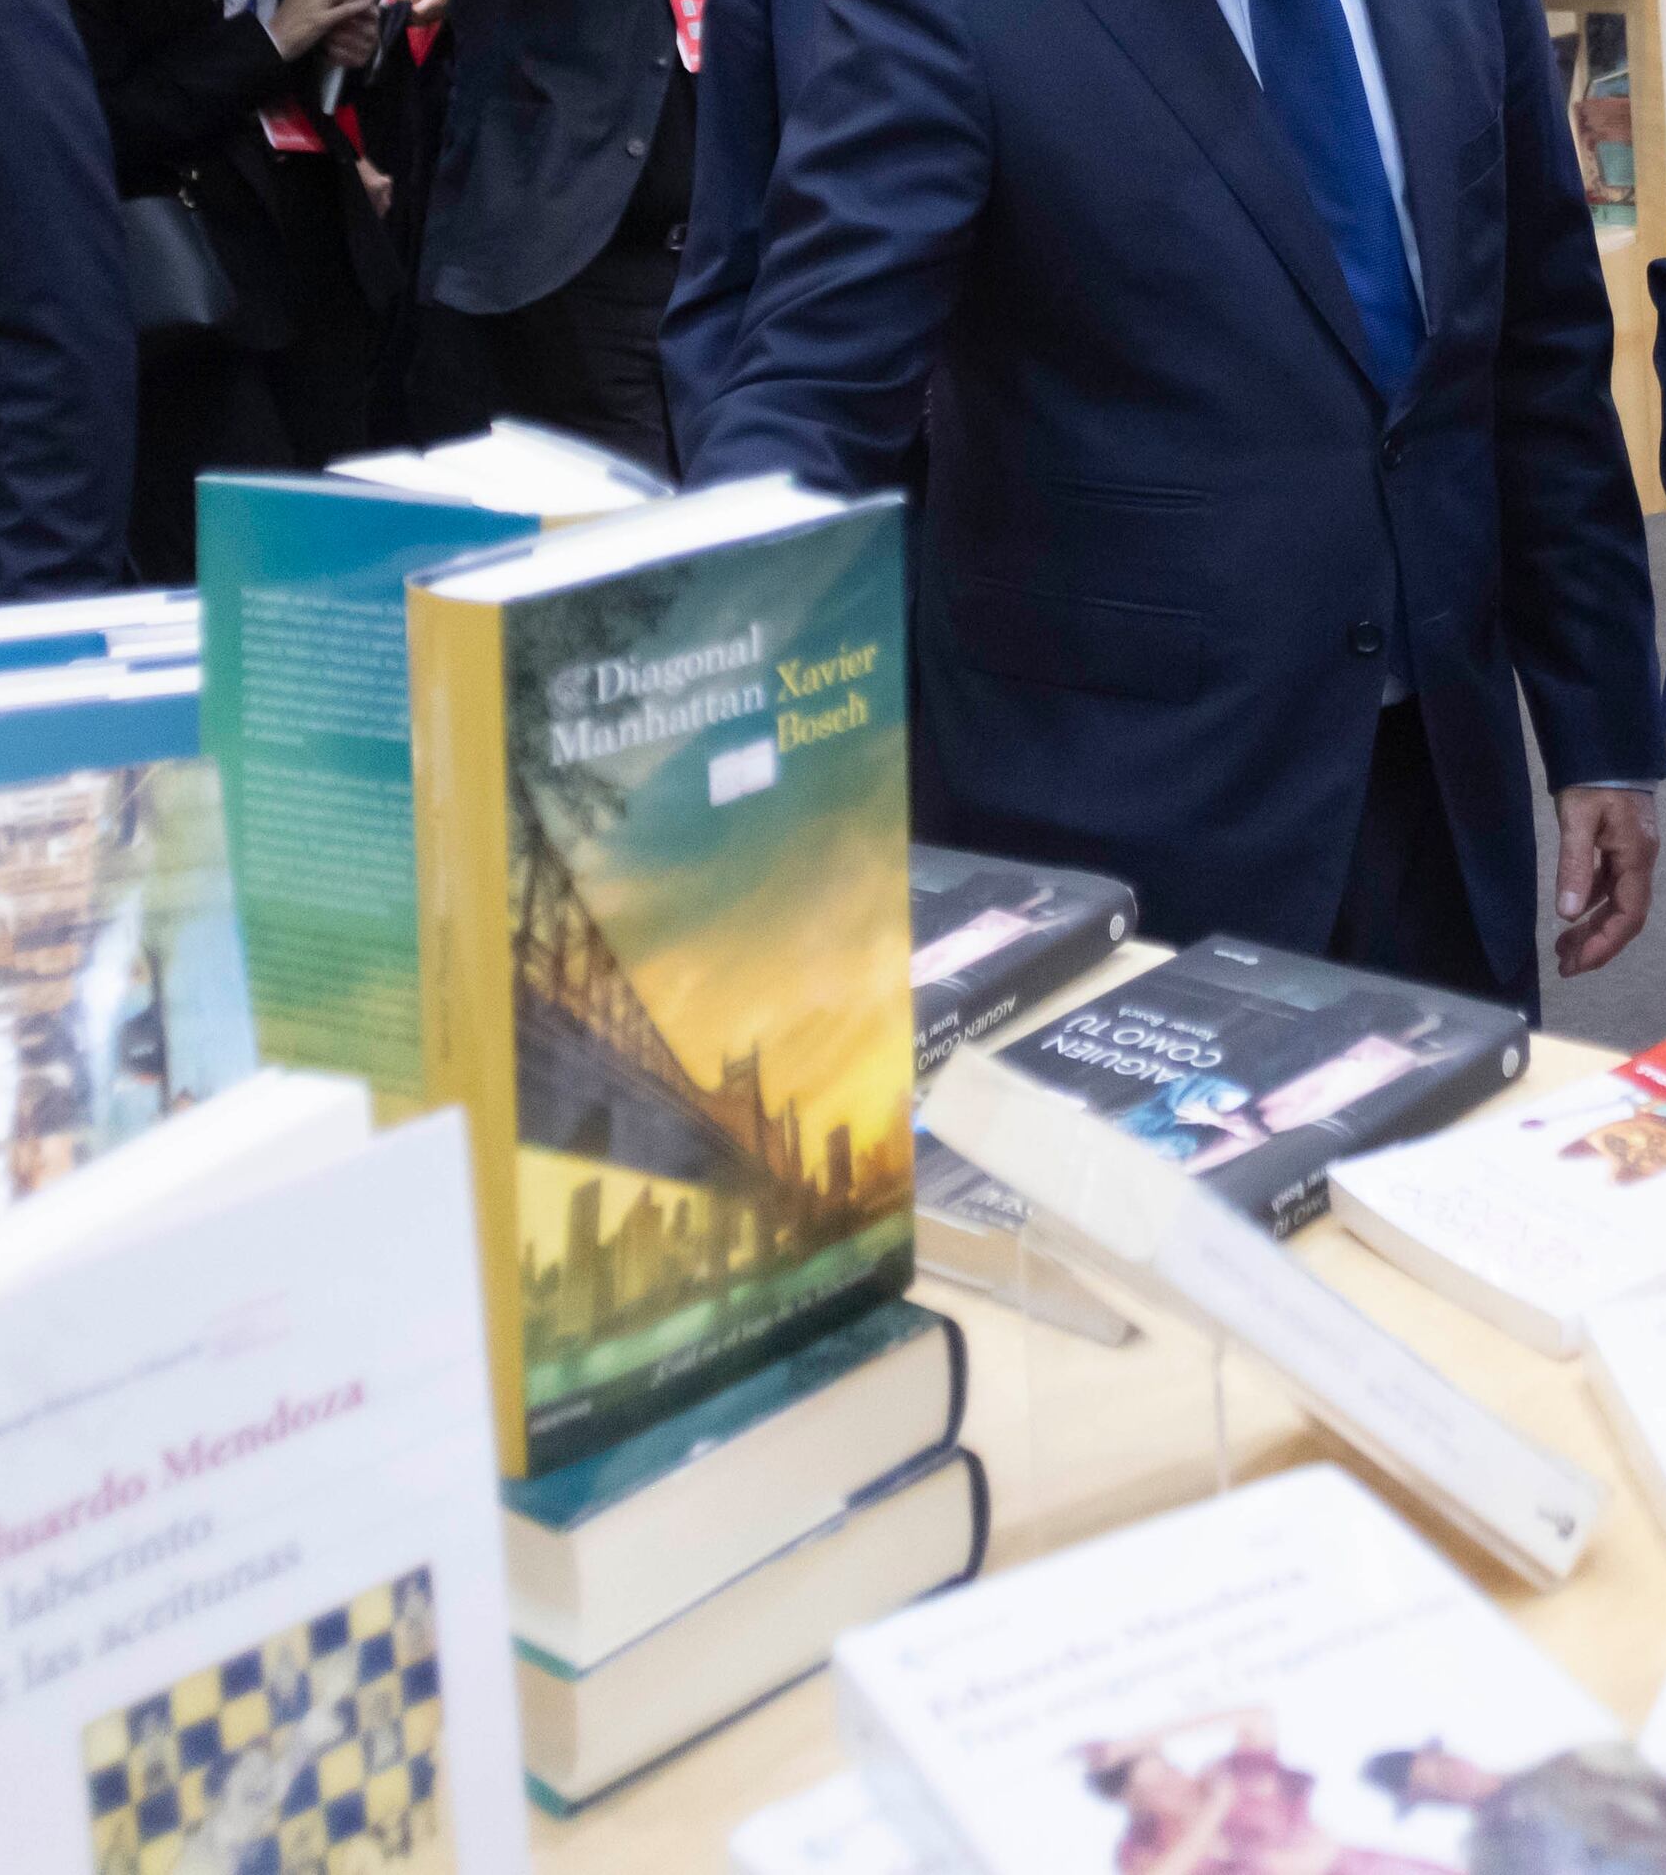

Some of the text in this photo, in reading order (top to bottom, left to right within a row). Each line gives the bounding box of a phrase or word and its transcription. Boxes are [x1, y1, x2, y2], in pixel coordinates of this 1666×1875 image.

[592, 624, 764, 707] Diagonal
[776, 640, 878, 703] Xavier
[547, 682, 765, 766] Manhattan
[776, 690, 870, 756] Bosch
[917, 992, 1018, 1071] ALGUIEN COMO
[928, 1010, 960, 1039] Xavier
[1040, 1033, 1184, 1086] ALGUIEN
[1062, 1014, 1223, 1069] COMO TÚ
[159, 1377, 367, 1489] Mendoza
[7, 1509, 216, 1631] laberinto
[21, 1643, 85, 1698] las
[96, 1539, 303, 1654] aceitunas
